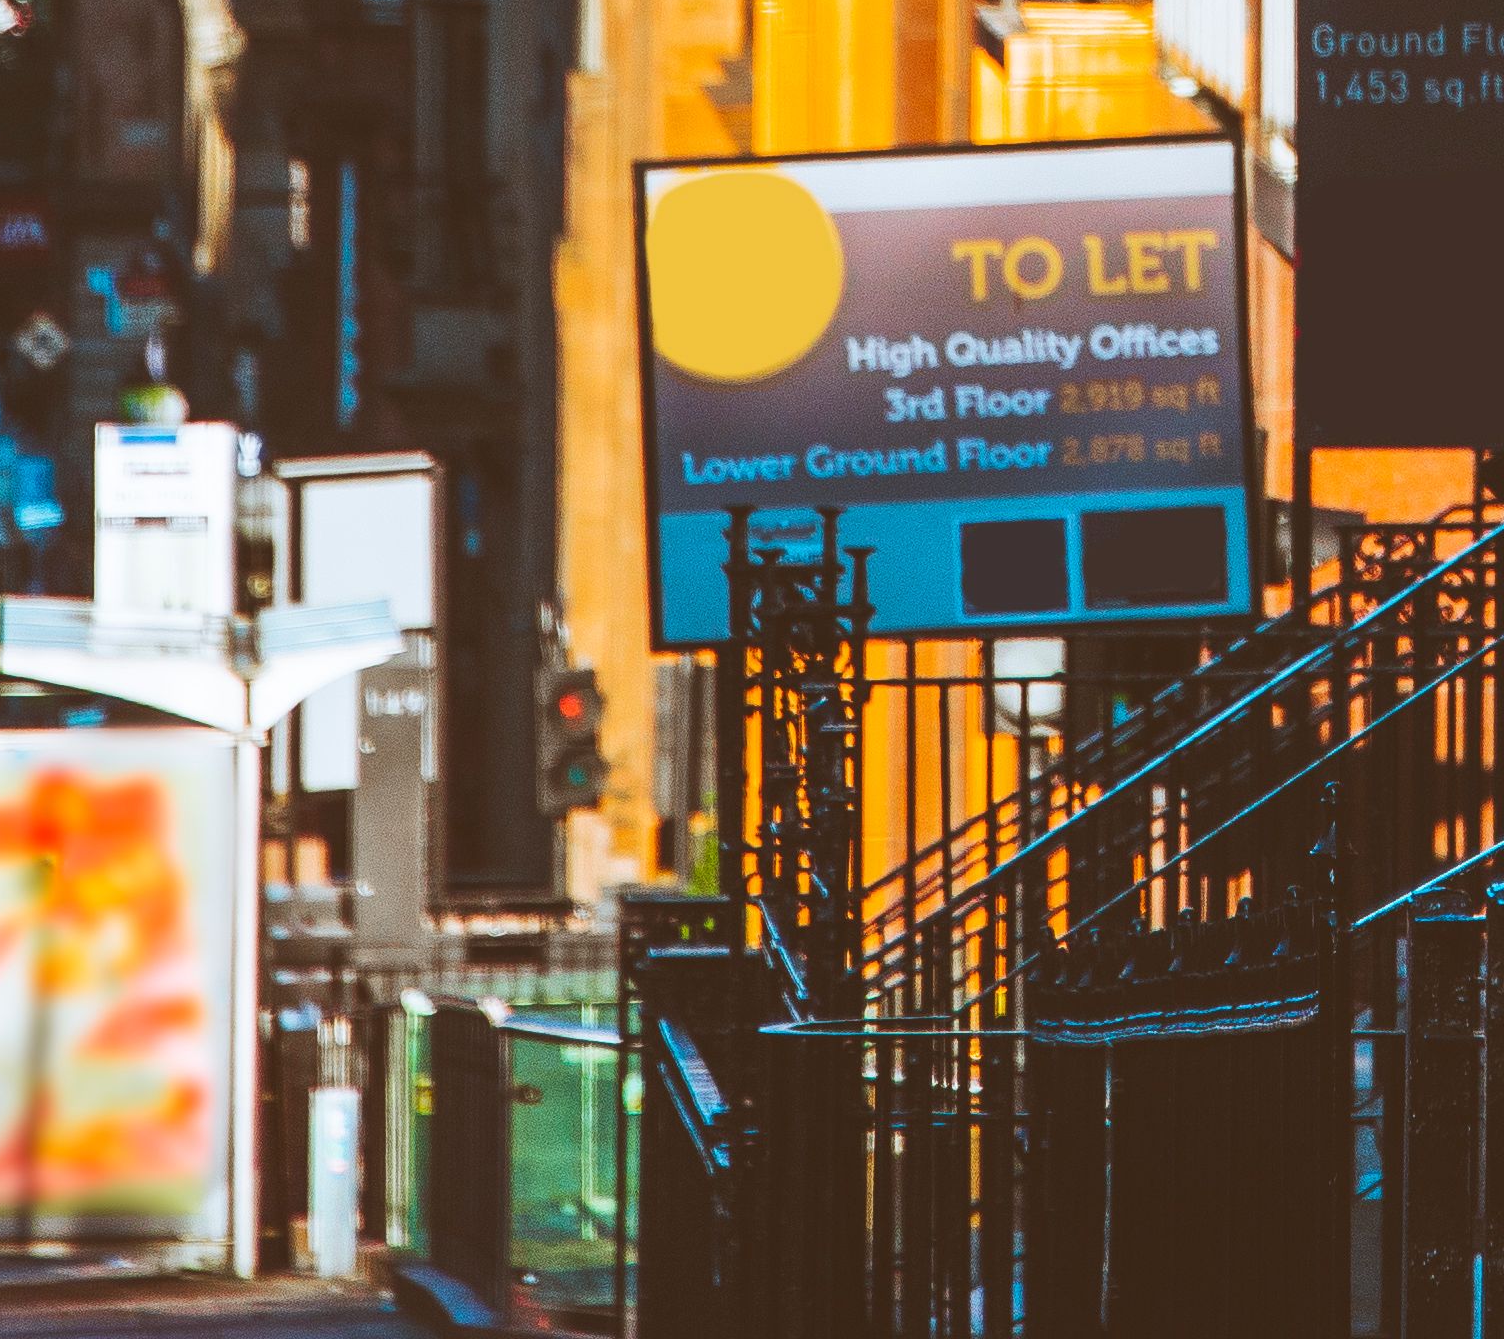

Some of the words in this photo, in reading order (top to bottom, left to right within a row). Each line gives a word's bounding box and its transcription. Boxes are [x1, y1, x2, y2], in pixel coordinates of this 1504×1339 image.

[1311, 22, 1445, 57] Ground
[1315, 69, 1410, 107] 1,453
[949, 233, 1065, 304] TO
[1081, 227, 1220, 297] LET
[846, 333, 939, 379] High
[946, 328, 1083, 371] Quality
[1089, 323, 1221, 361] Offices
[885, 387, 946, 422] 3rd
[954, 383, 1052, 417] Floor
[1151, 383, 1189, 415] sq
[1196, 374, 1221, 404] ft
[682, 452, 797, 486] Lower
[804, 440, 949, 480] Ground
[956, 437, 1053, 470] Floor
[1155, 438, 1190, 465] sq
